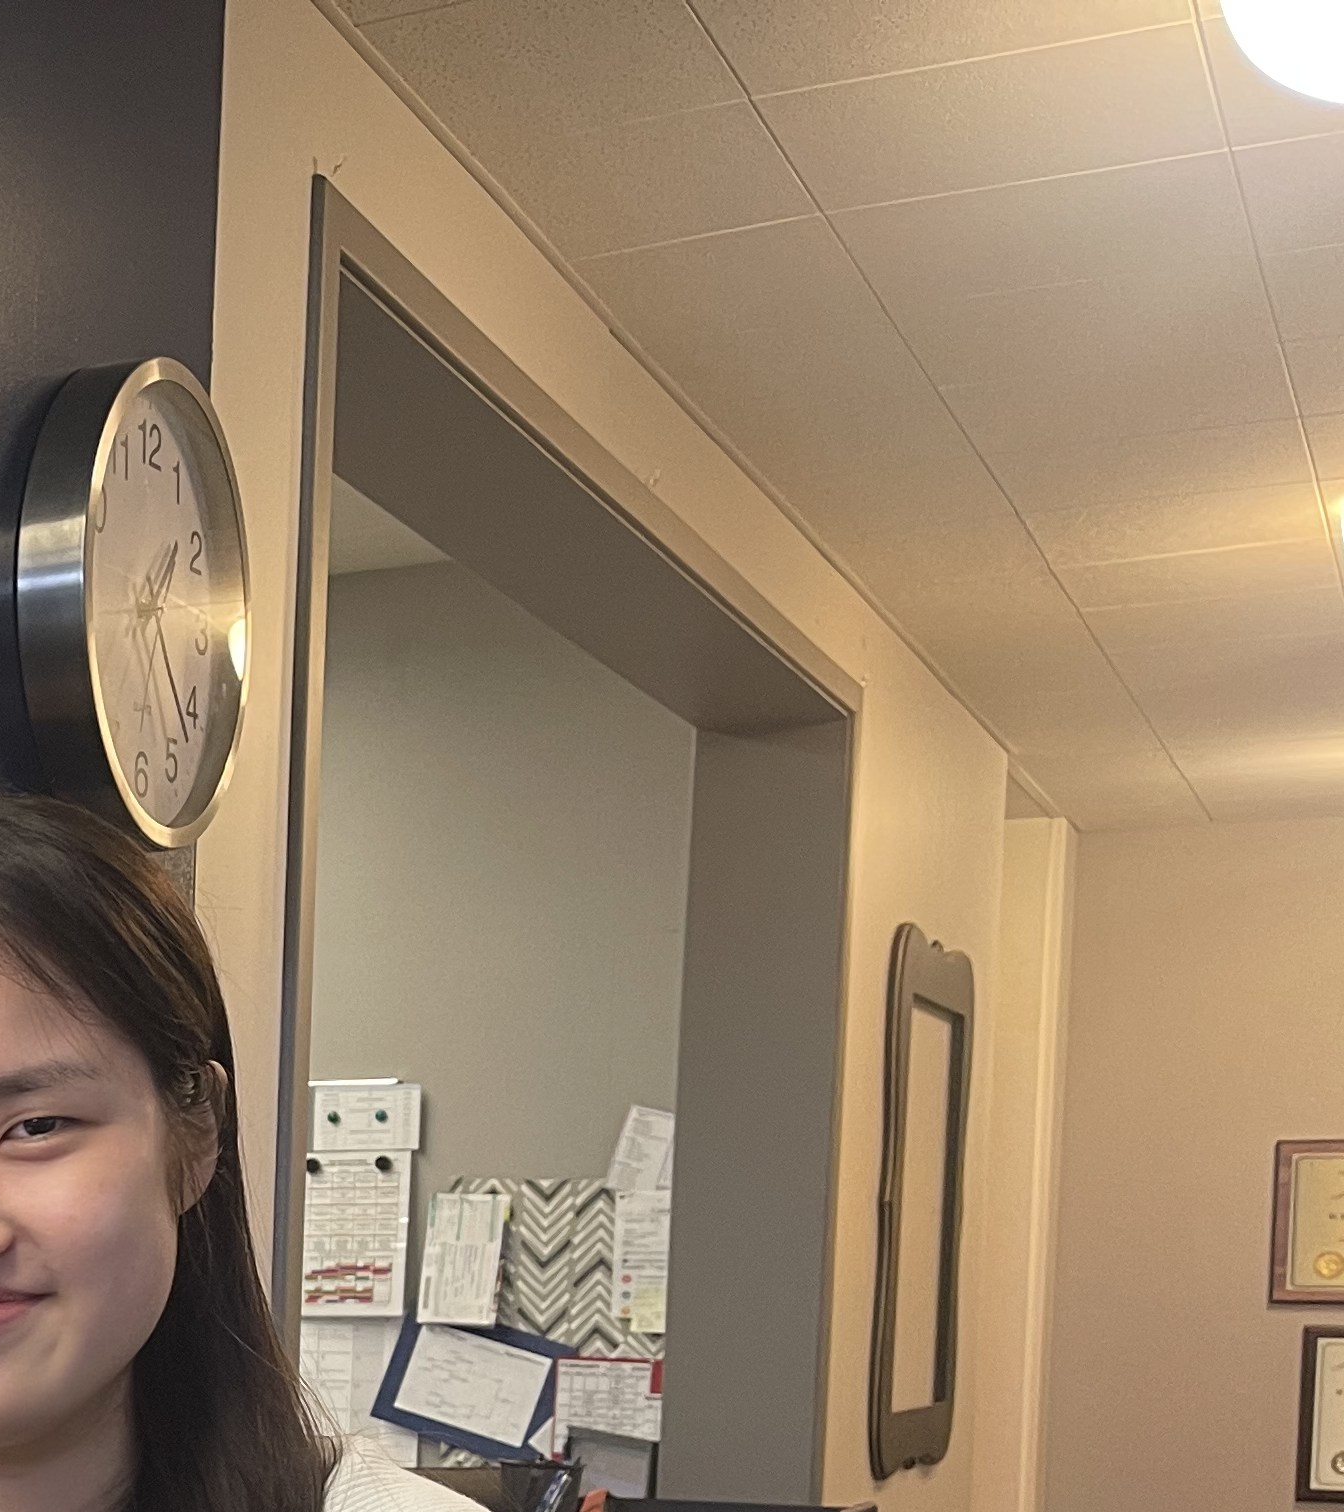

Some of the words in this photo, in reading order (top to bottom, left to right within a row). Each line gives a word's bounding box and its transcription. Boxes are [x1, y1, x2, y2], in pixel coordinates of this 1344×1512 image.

[137, 418, 162, 472] 12
[172, 460, 180, 505] 1
[190, 530, 202, 575] 2
[194, 608, 208, 656] 3
[186, 685, 199, 729] 4
[134, 751, 148, 798] 6
[165, 737, 178, 783] 5
